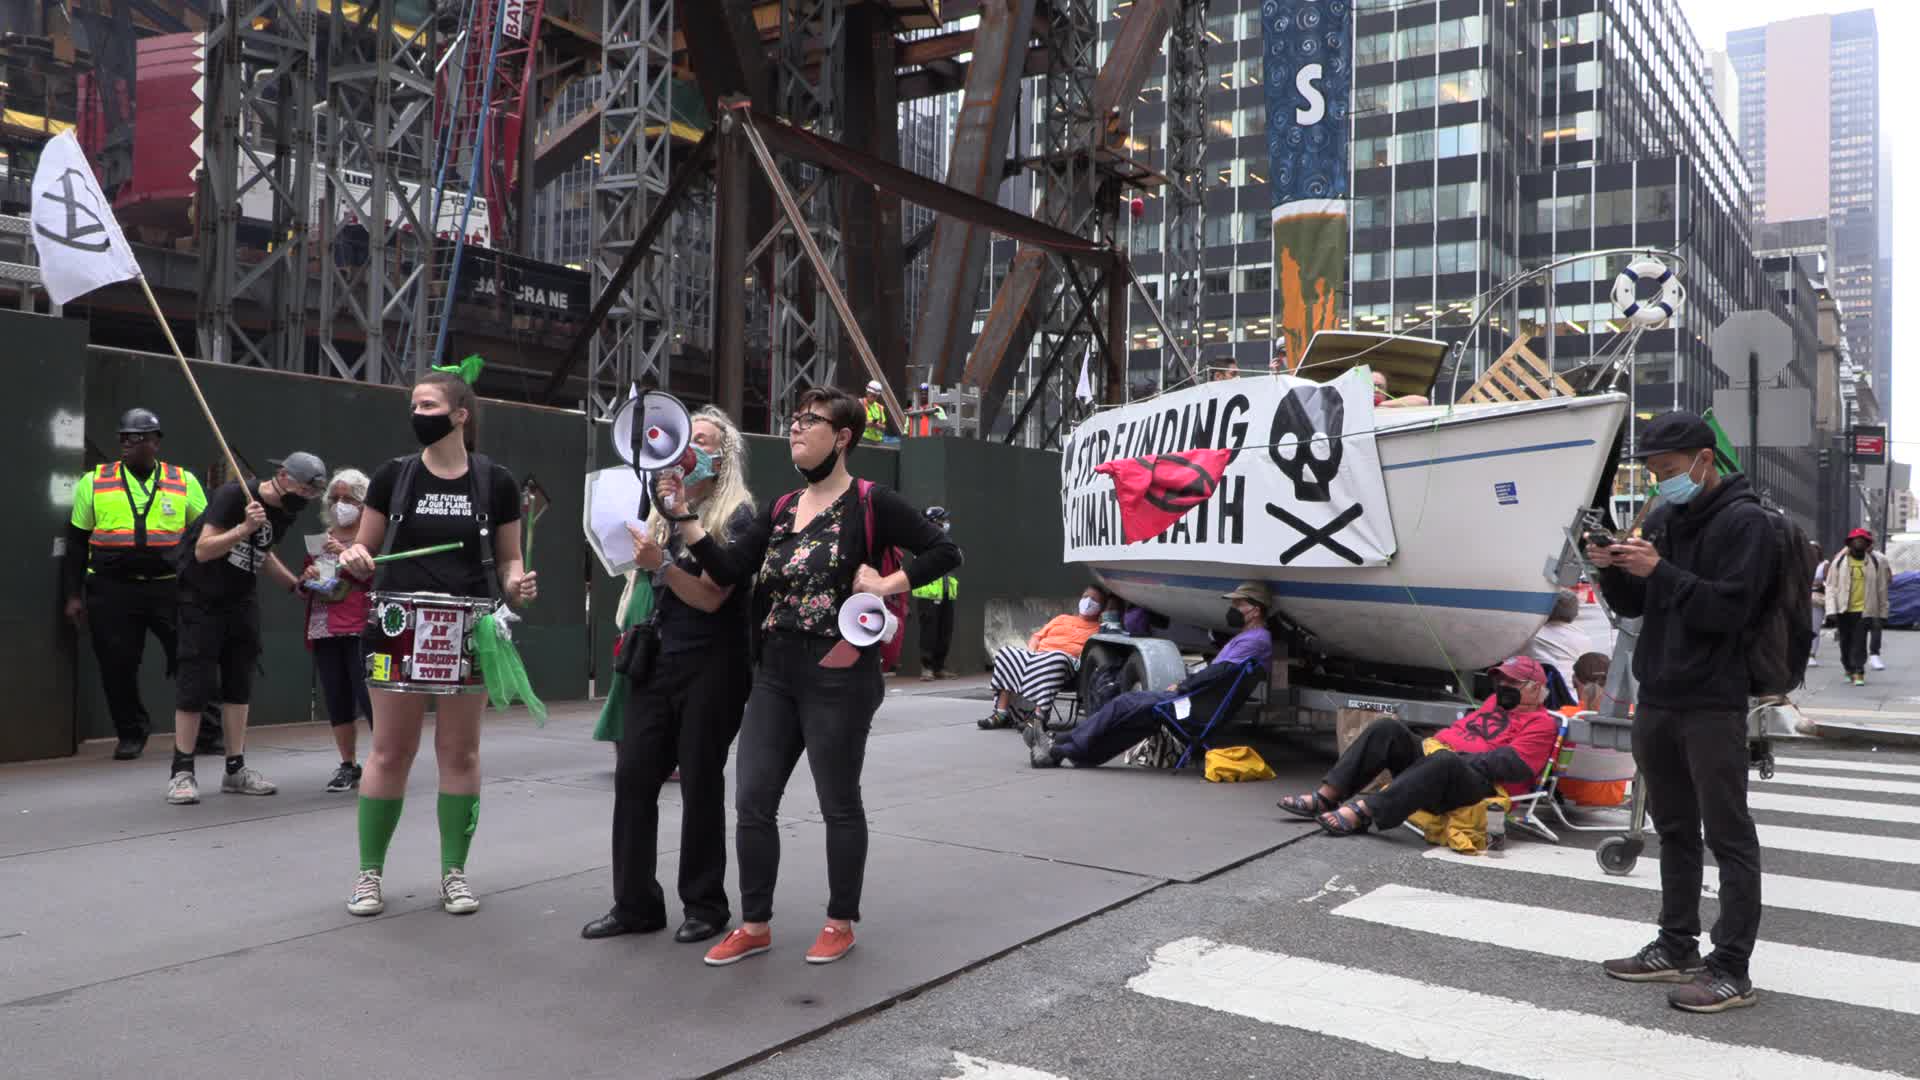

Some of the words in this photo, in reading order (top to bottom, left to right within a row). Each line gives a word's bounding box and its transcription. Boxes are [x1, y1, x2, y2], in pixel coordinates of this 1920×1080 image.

[1296, 64, 1325, 126] S
[1112, 394, 1250, 466] FUNDING
[416, 507, 448, 515] DEPENDS
[450, 508, 460, 516] ON
[425, 493, 439, 501] THE
[440, 494, 468, 502] FUTURE
[1071, 488, 1126, 549] CLIMAT
[419, 667, 452, 679] TOWN
